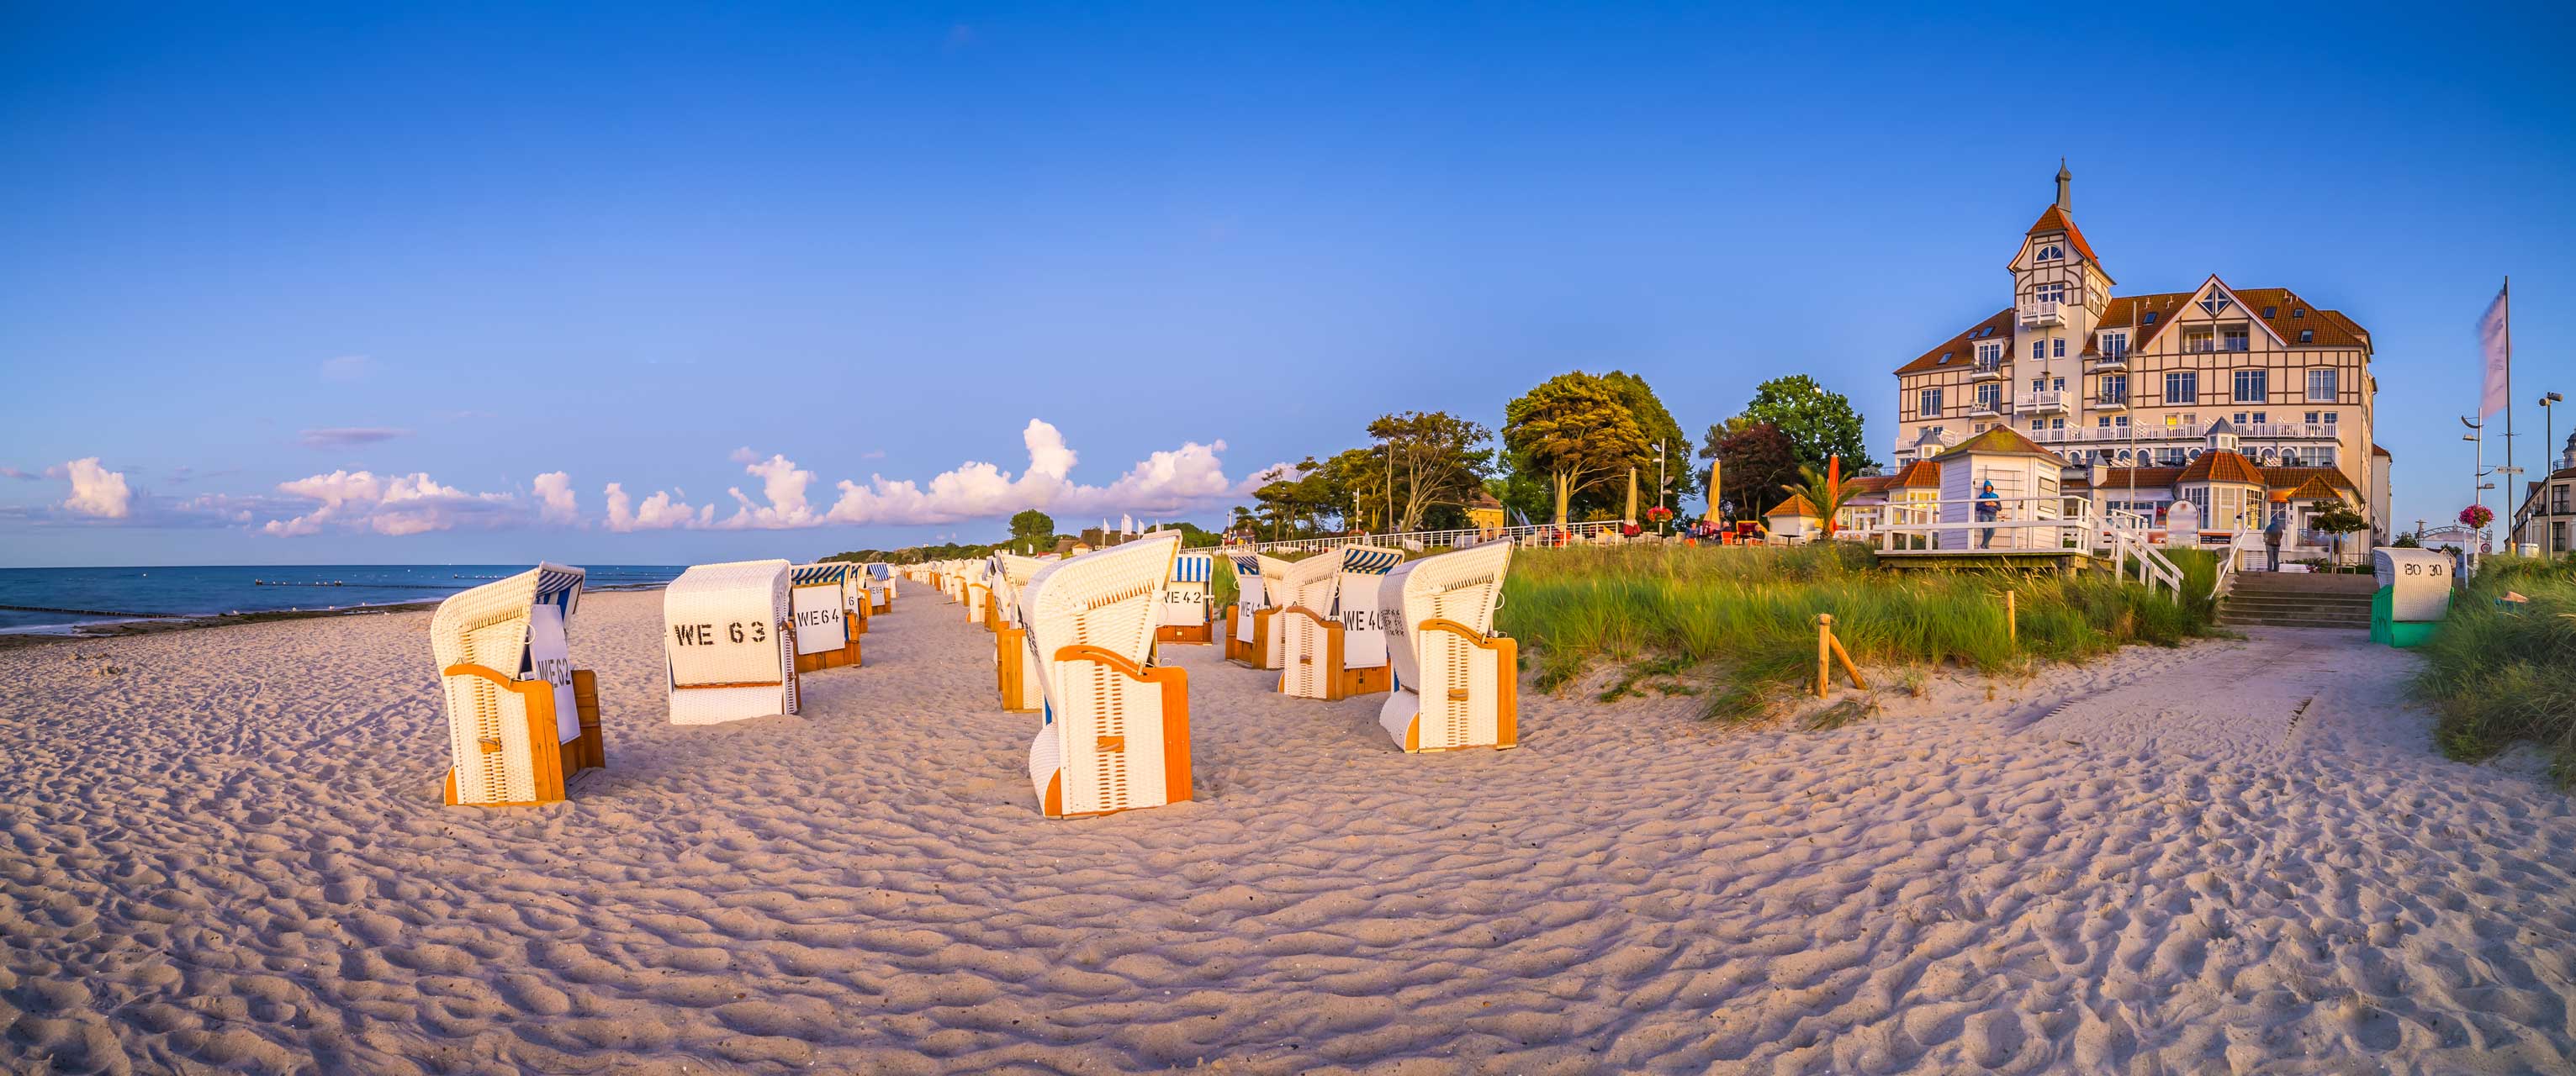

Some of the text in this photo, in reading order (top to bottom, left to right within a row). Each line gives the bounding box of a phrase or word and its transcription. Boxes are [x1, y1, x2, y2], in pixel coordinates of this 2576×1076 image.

[2429, 564, 2442, 577] 30
[674, 621, 766, 646] WE 63
